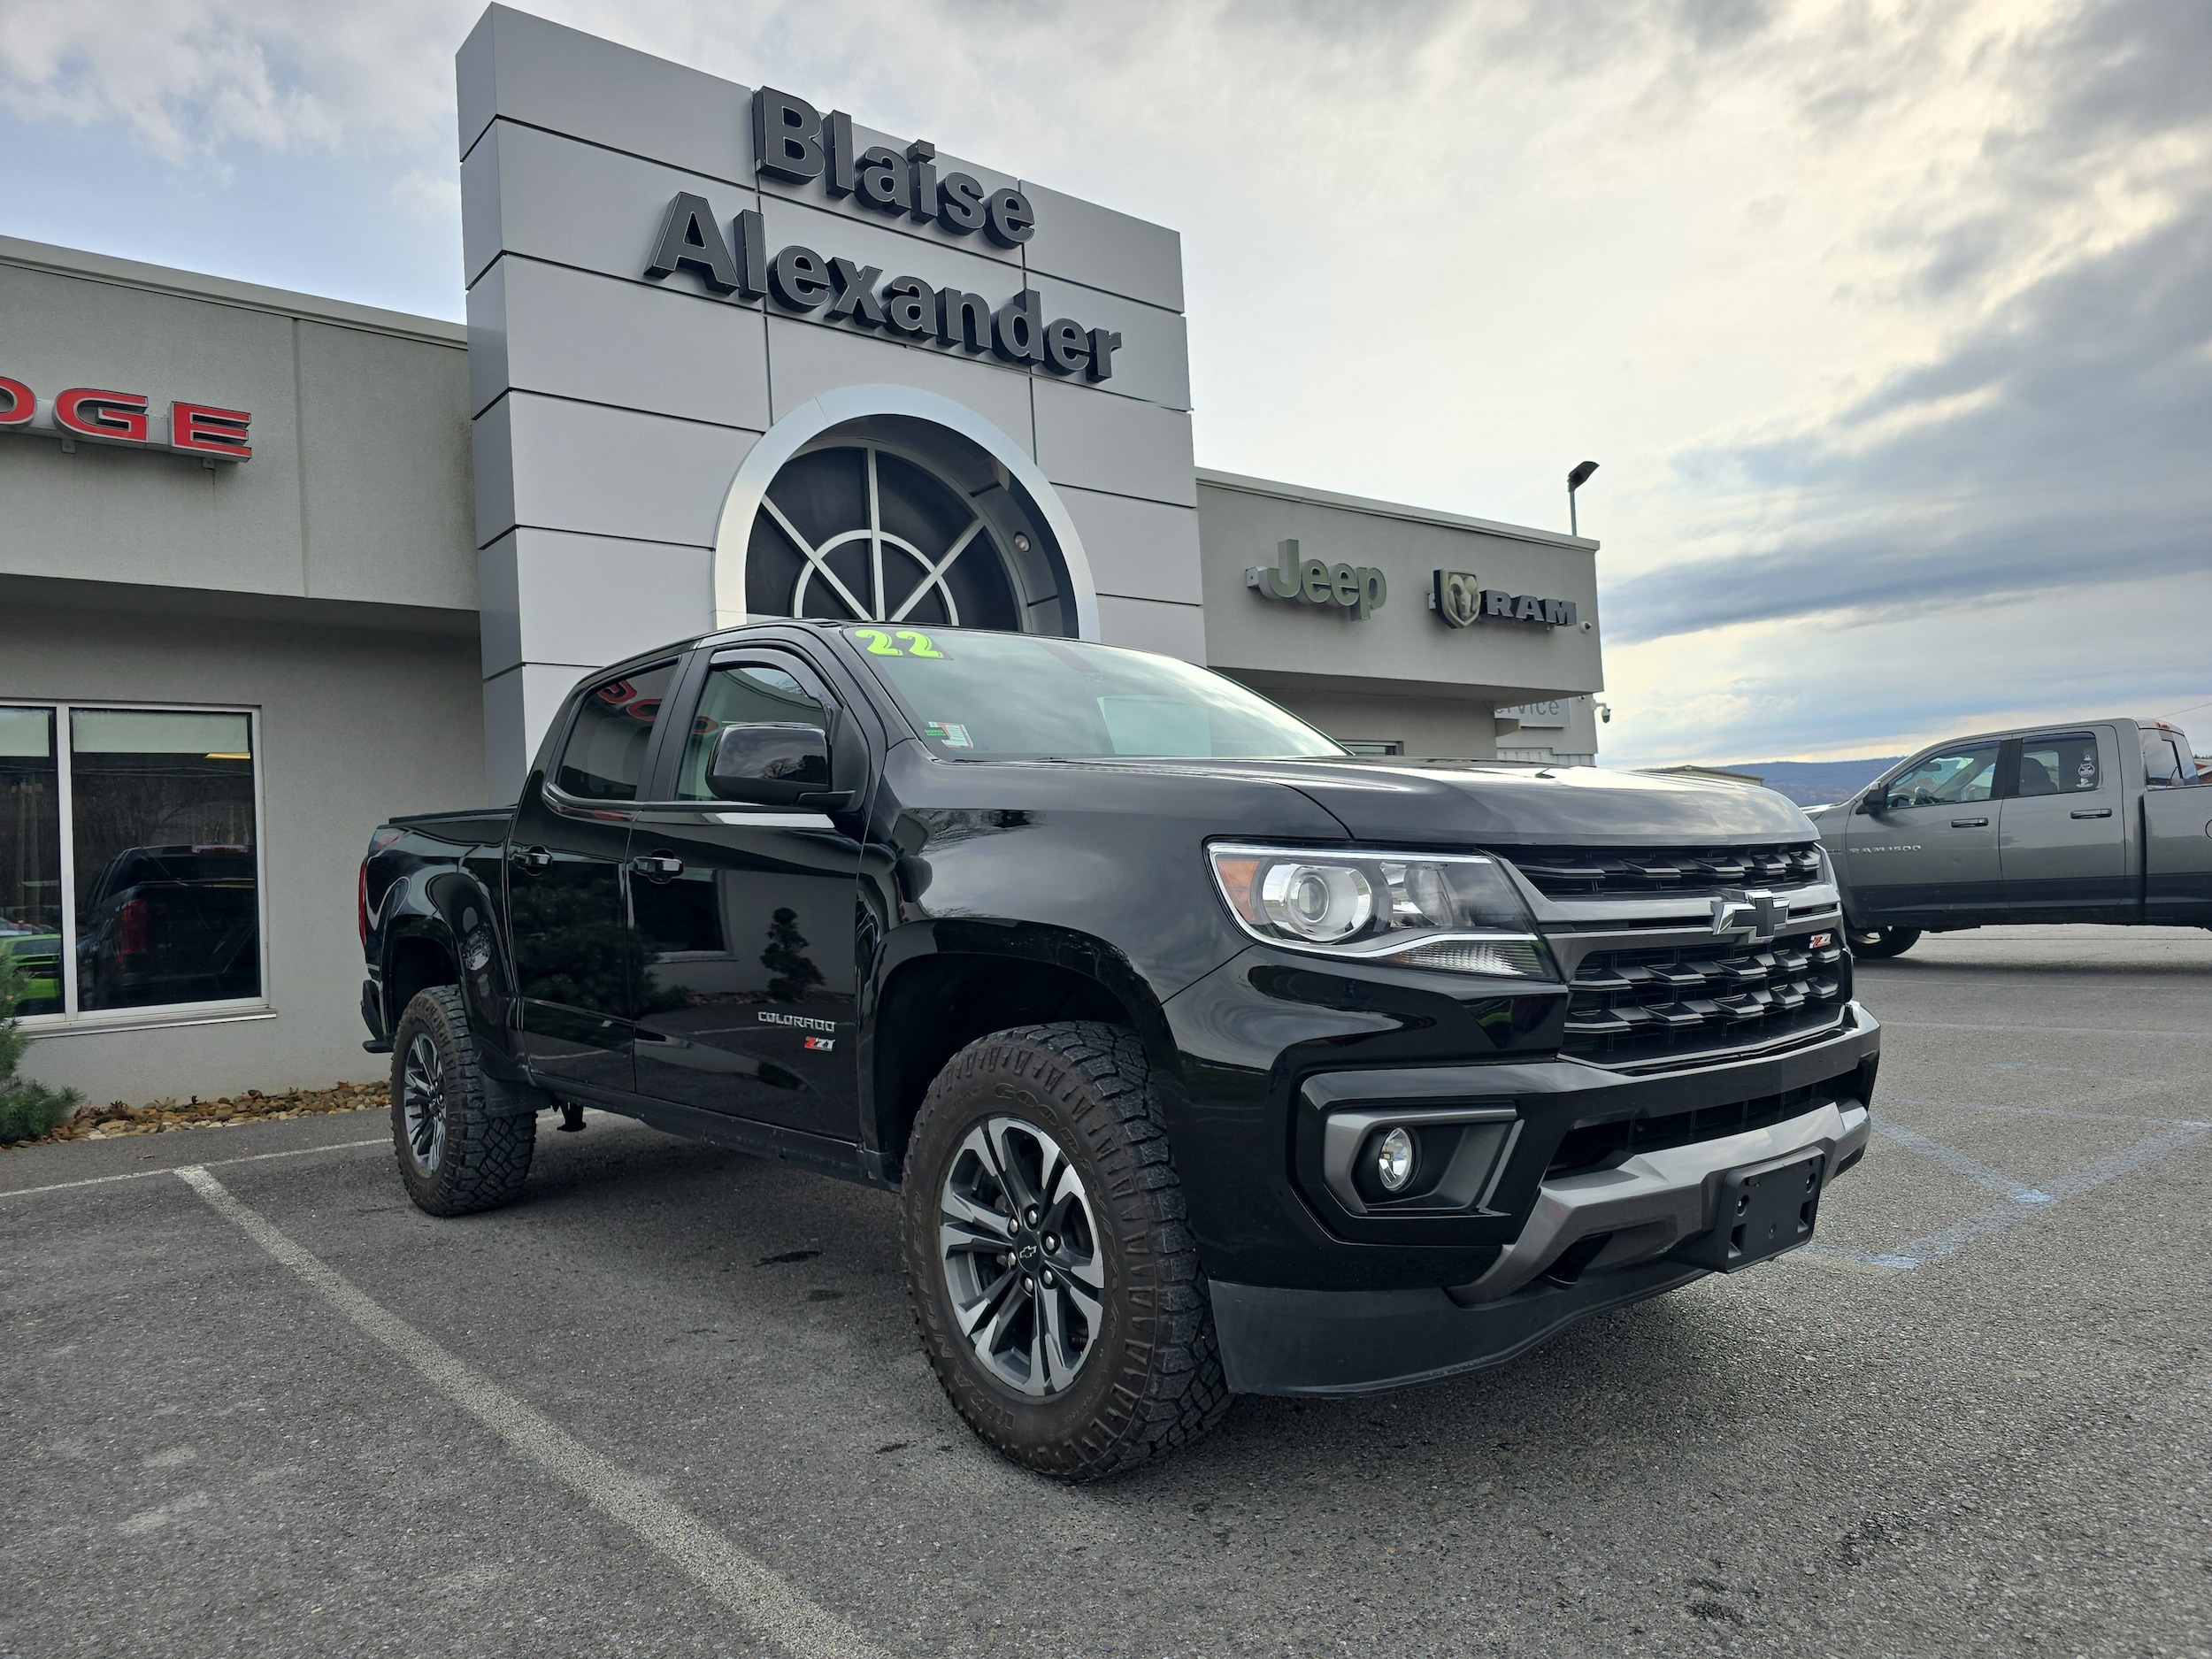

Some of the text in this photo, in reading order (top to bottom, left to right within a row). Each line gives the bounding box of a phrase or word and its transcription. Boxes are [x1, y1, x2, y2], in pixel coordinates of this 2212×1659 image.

[753, 86, 1034, 250] Blaise
[643, 191, 1122, 383] Alexander
[1258, 539, 1387, 620] Jeep
[1481, 589, 1578, 626] RAM
[855, 629, 944, 658] 22
[757, 1011, 835, 1033] COLORADO
[994, 1081, 1120, 1340] GOODYEAR
[912, 1191, 1016, 1432] WRANGLER
